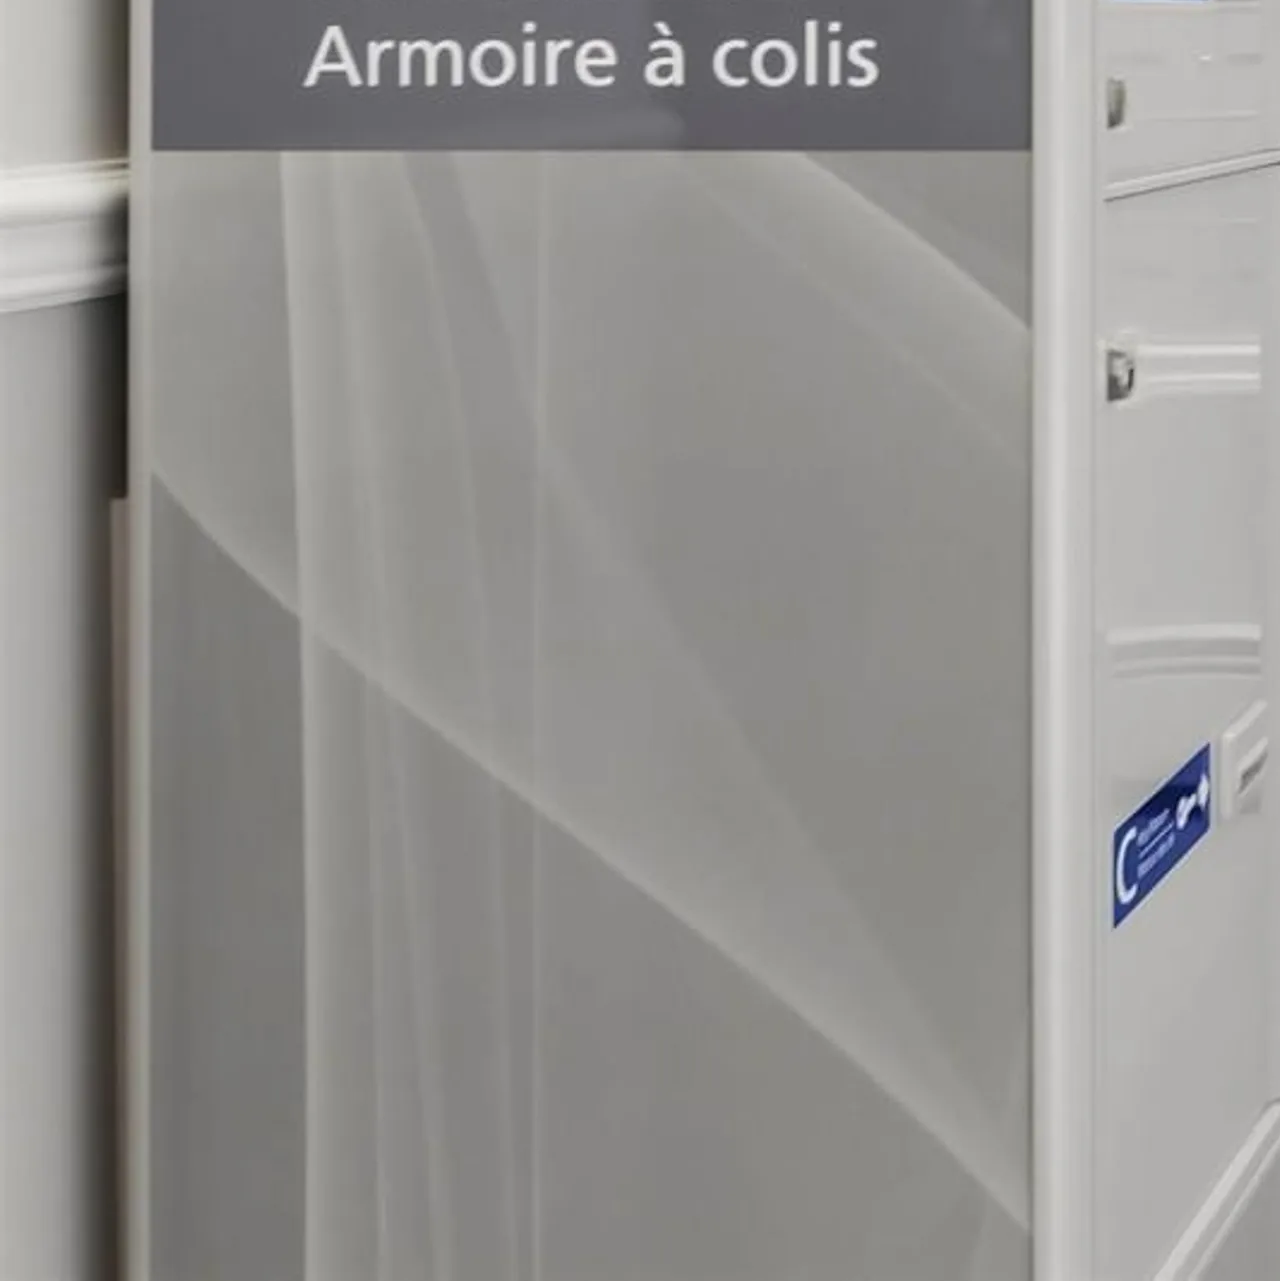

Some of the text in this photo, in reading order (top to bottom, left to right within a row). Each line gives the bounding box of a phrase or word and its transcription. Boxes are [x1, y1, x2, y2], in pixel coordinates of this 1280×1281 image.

[303, 20, 879, 87] Armoire à colis
[1116, 825, 1138, 906] C
